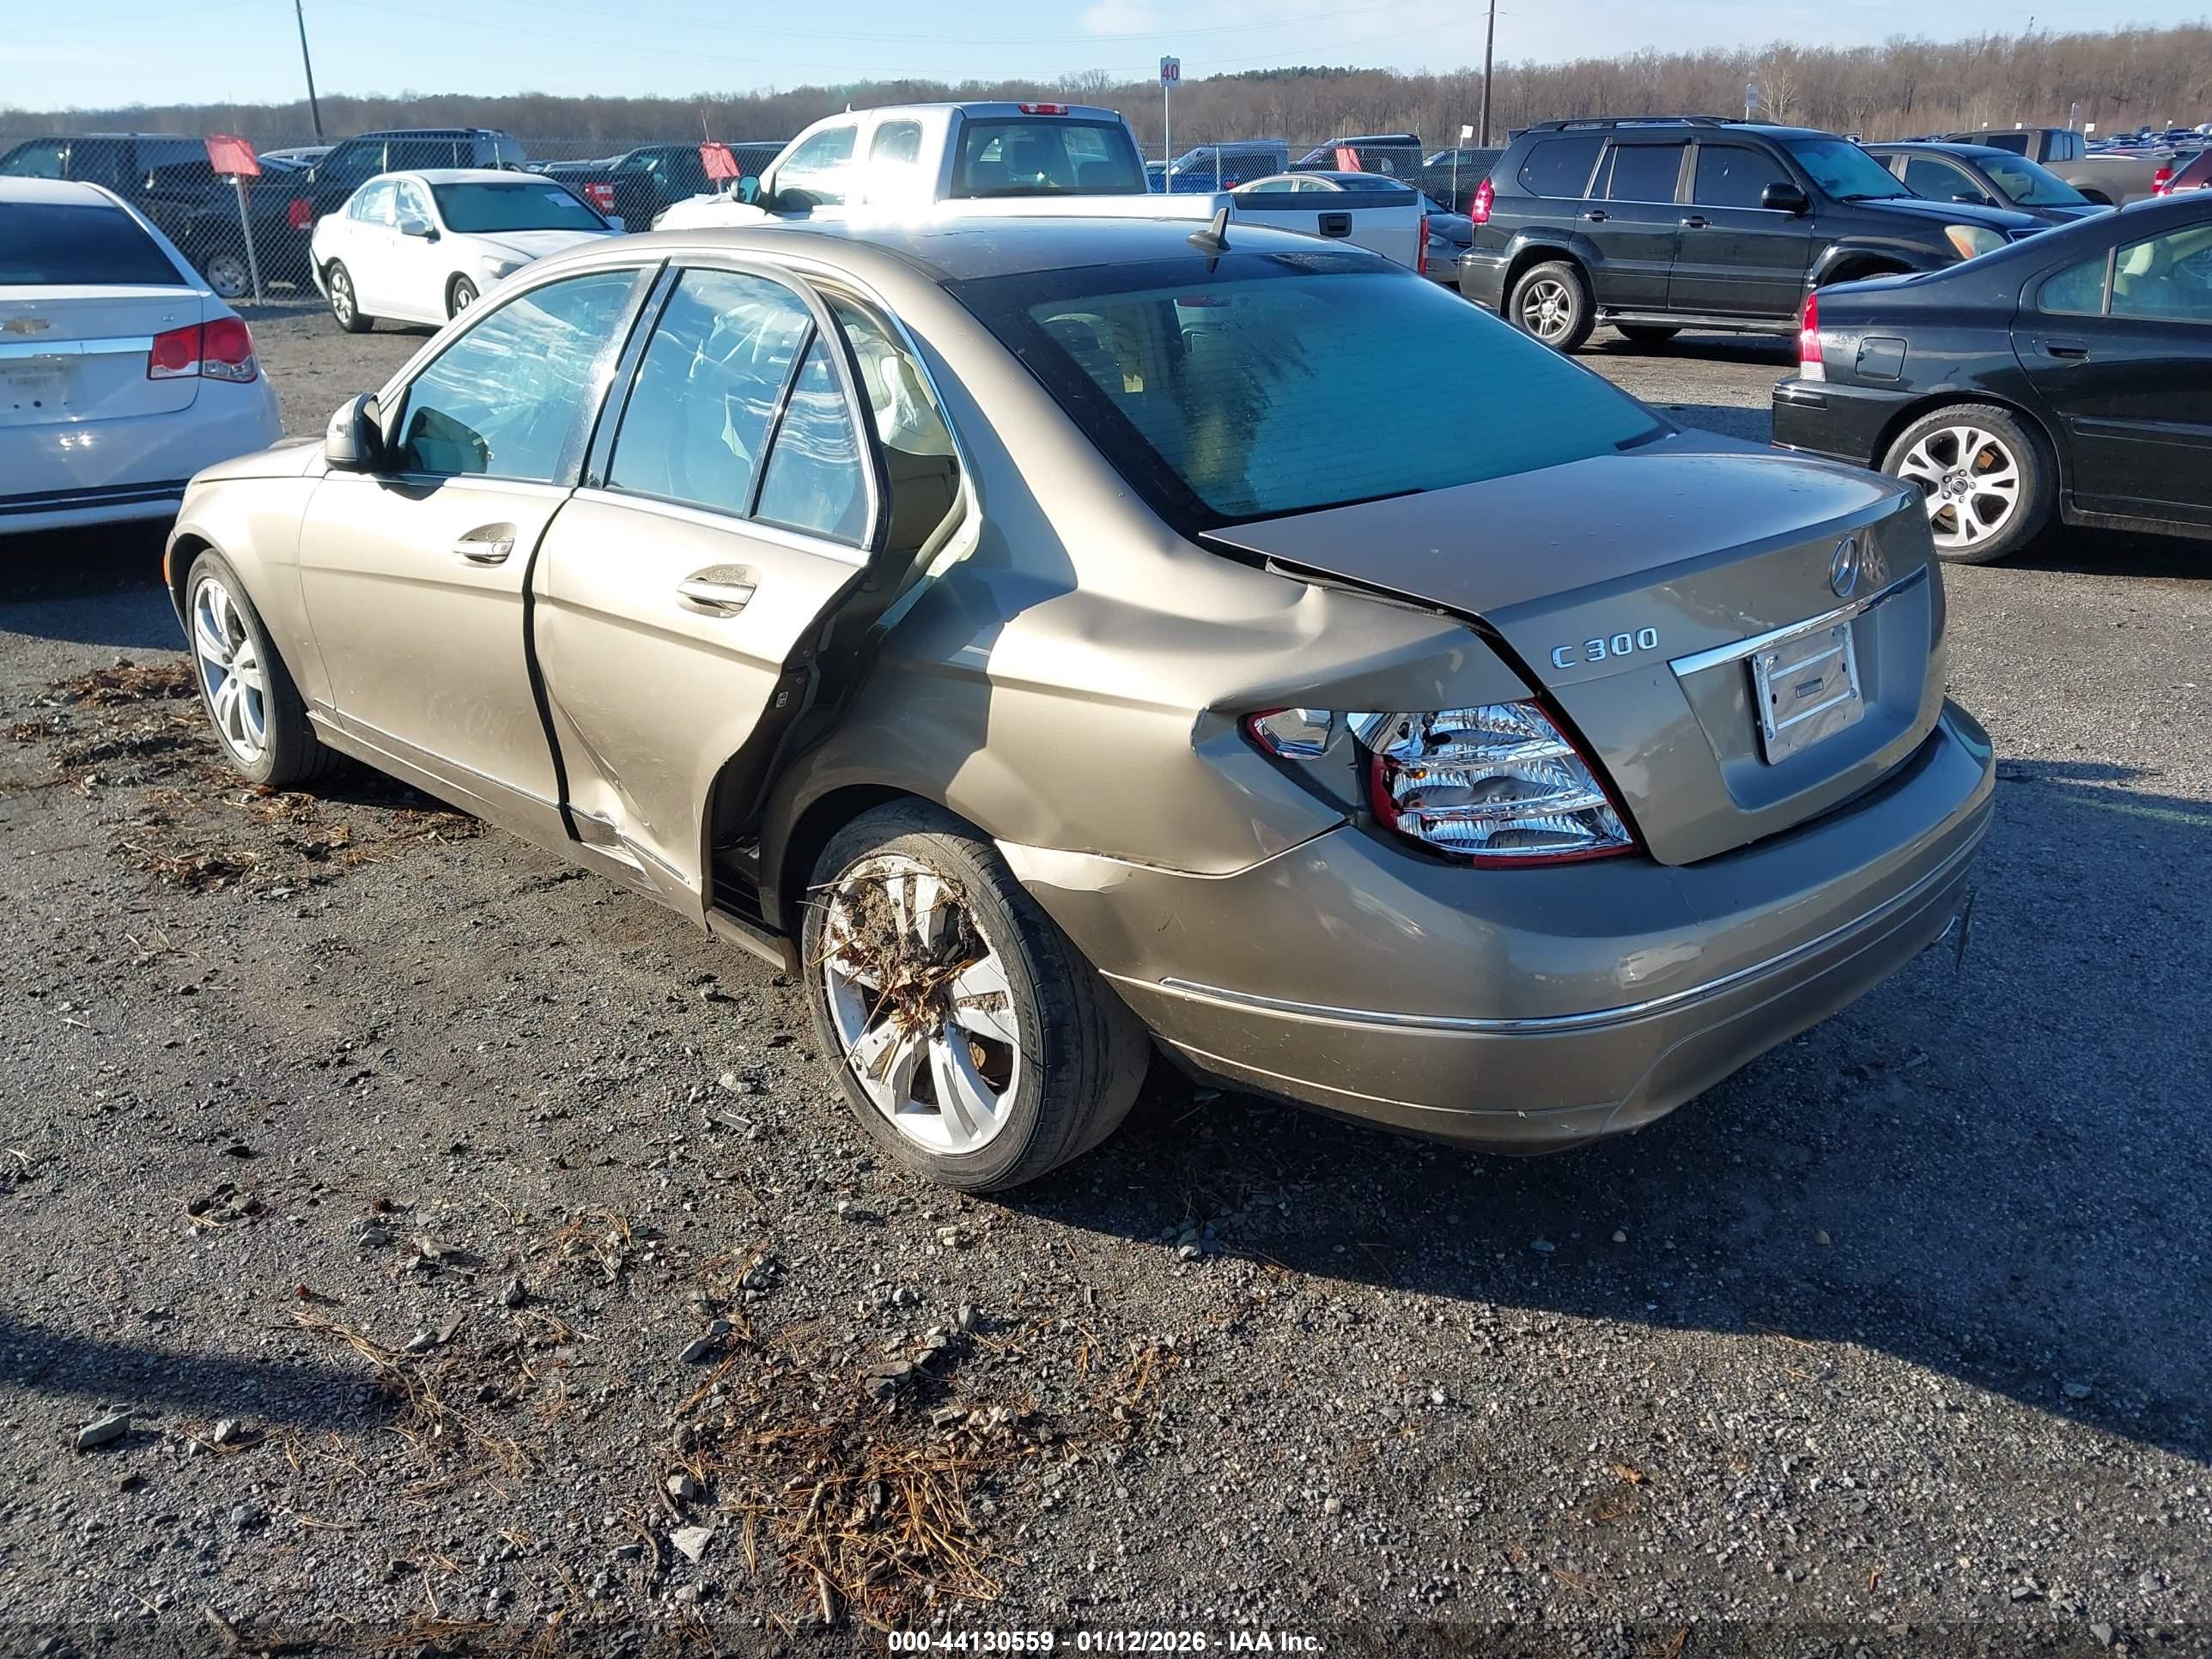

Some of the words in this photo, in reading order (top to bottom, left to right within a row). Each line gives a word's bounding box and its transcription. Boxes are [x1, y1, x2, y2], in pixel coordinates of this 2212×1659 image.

[1162, 64, 1179, 82] 40
[1551, 645, 1577, 669] C
[1583, 626, 1658, 662] 300
